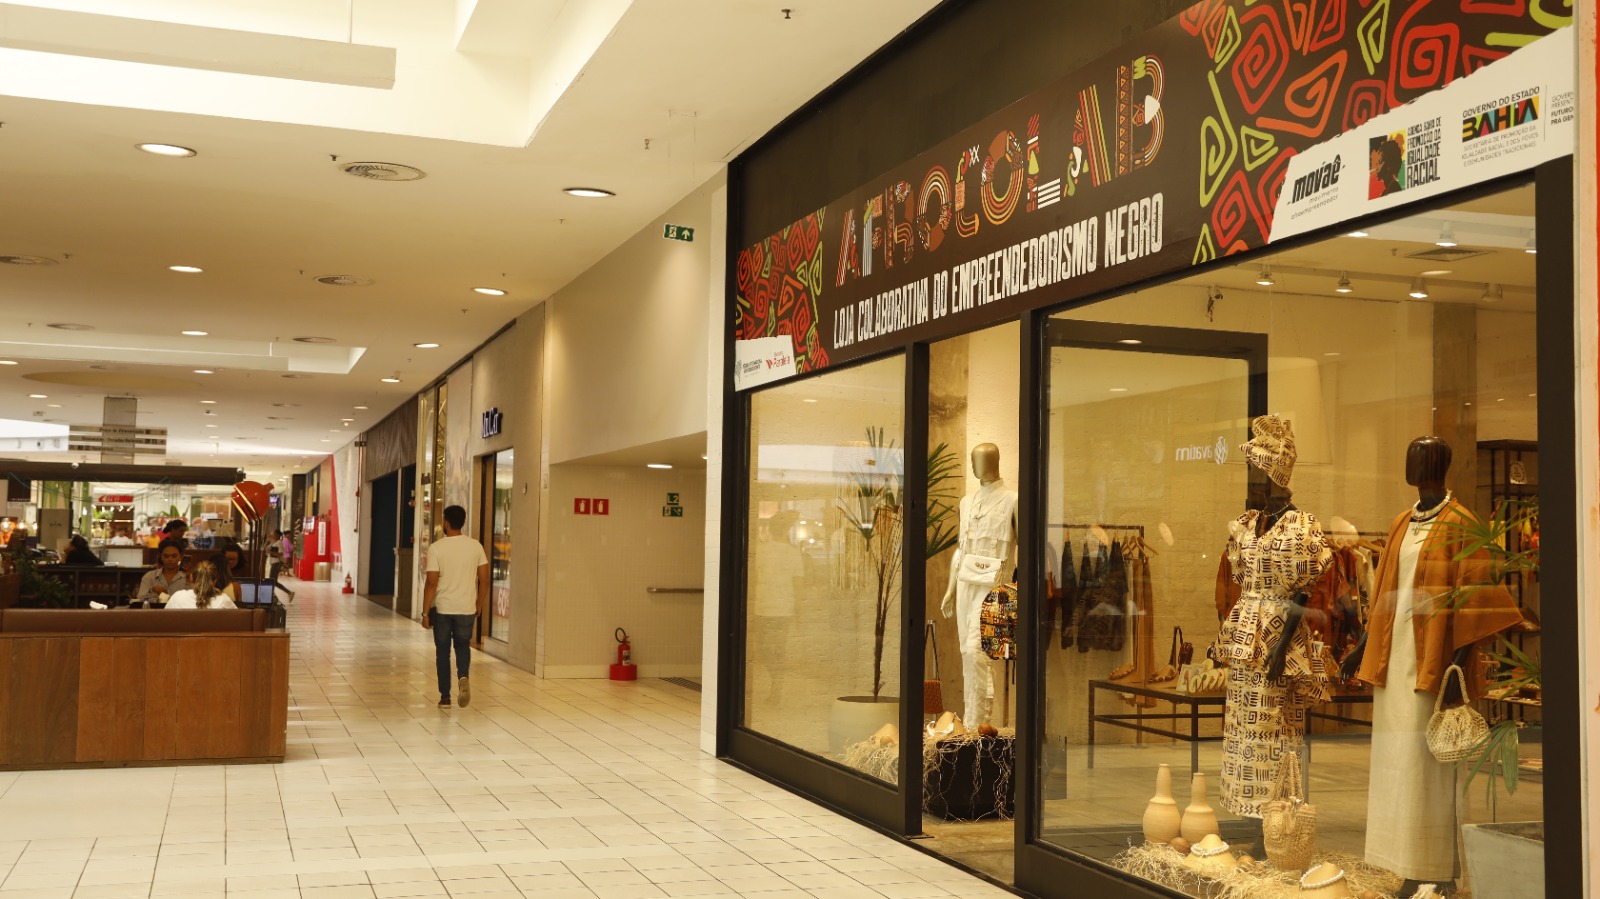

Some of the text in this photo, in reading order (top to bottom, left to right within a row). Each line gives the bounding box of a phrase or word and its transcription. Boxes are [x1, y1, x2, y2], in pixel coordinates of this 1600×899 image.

[1462, 86, 1540, 118] GOVERNO DO ESTADO
[1462, 98, 1538, 143] BAHIA
[1551, 117, 1562, 125] PRA
[1407, 141, 1441, 166] IGUALDADE
[836, 54, 1165, 288] AFROCOLAB
[1406, 158, 1441, 189] RACIAL
[833, 192, 1163, 350] LOJA COLABORATIVA DO EMPREENDEDORISMO NEGRO
[667, 494, 679, 503] L2
